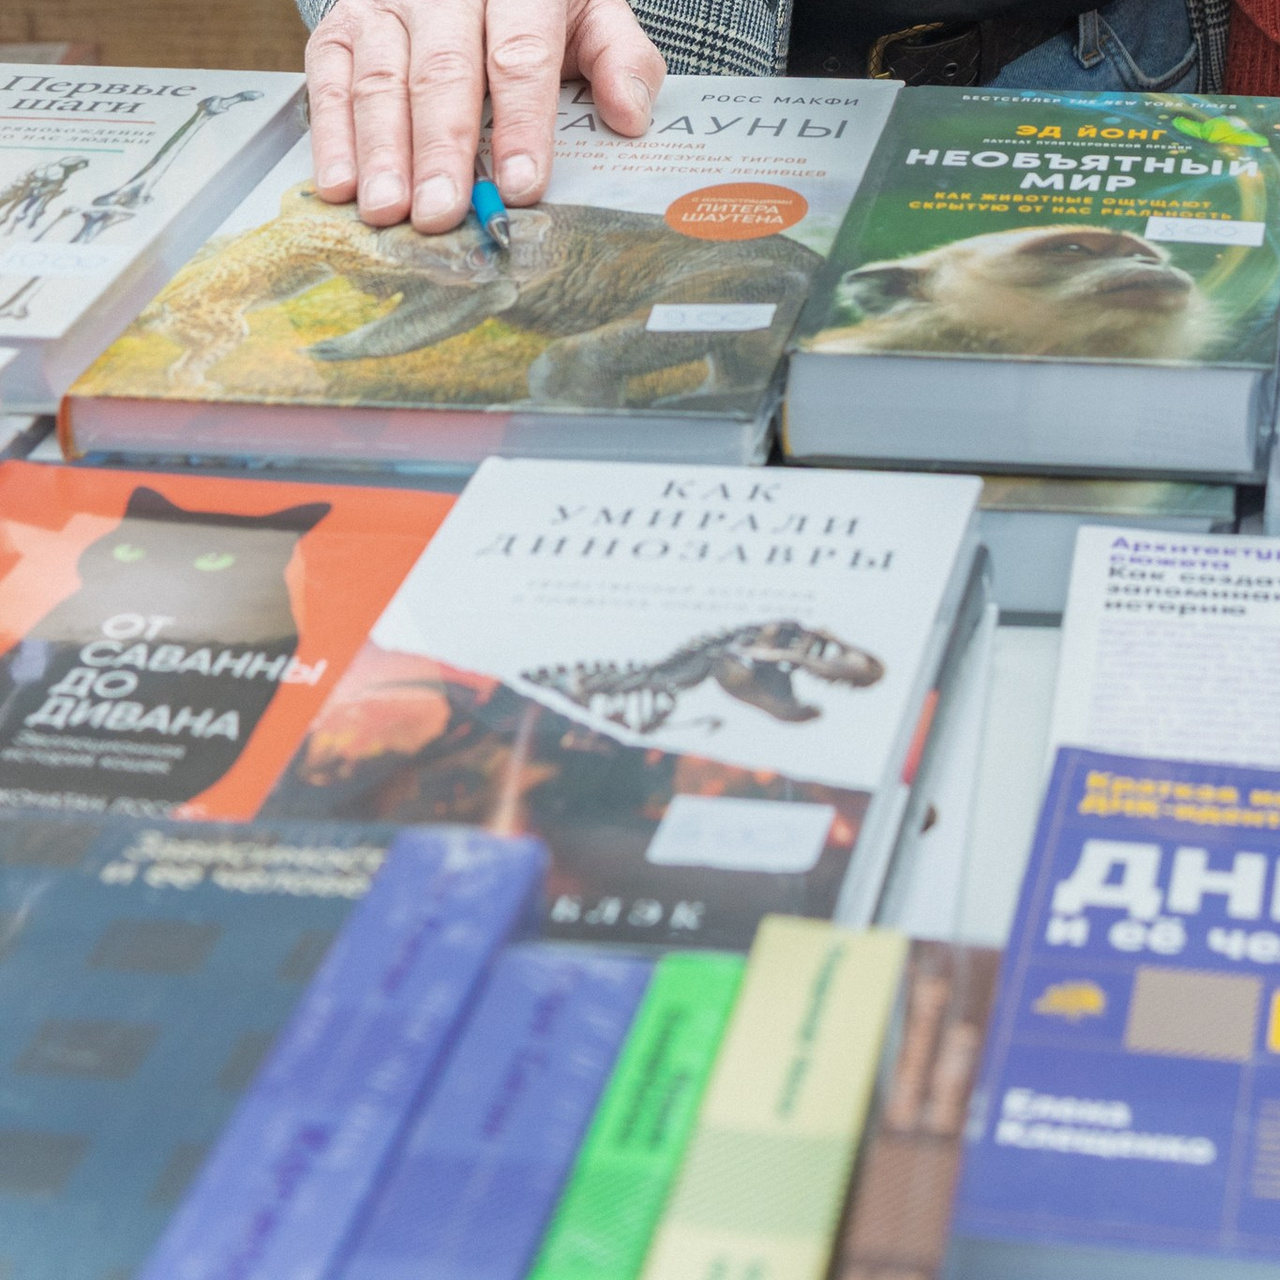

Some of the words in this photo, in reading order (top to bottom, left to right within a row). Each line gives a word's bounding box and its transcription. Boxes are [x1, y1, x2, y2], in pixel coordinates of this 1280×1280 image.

[0, 75, 198, 99] Первые
[7, 99, 144, 114] шаги
[701, 94, 763, 105] РОСС
[773, 96, 860, 107] МАКФИ
[962, 95, 1061, 105] БЕСТСЕЛЛЕР
[0, 125, 157, 137] РЯМОХОЖДЕНИЕ
[1016, 124, 1063, 140] ЭД
[1077, 124, 1168, 141] ЙОНГ
[595, 140, 706, 150] ЗАГАДОЧНАЯ
[617, 153, 732, 164] САБЛЕЗУБЫХ
[741, 156, 808, 165] ТИГРОВ
[905, 148, 1259, 176] НЕОБЪЯТНЫЙ
[1019, 172, 1137, 192] МИР
[697, 204, 780, 215] ПИТЕРА
[934, 192, 972, 201] КАК
[979, 193, 1094, 205] ЖИВОТНЫЕ
[1103, 197, 1212, 209] ОЩУЩАЮТ
[681, 213, 784, 226] ШАУТЕНА
[908, 201, 1010, 213] СКРЫТУЮ
[1017, 204, 1043, 214] ОТ
[1052, 205, 1092, 215] НАС
[1101, 207, 1233, 220] РЕАЛЬНОСТЬ
[662, 480, 782, 504] КАК
[551, 505, 861, 538] УМИРАЛИ
[475, 532, 898, 572] ДИНОЗАВРЫ
[1107, 565, 1166, 581] Как
[101, 612, 176, 641] ОТ
[79, 640, 329, 687] САВАННЫ
[47, 666, 139, 700] ДО
[24, 696, 240, 742] ДИВАНА
[1045, 915, 1091, 947] и
[1107, 915, 1187, 956] её
